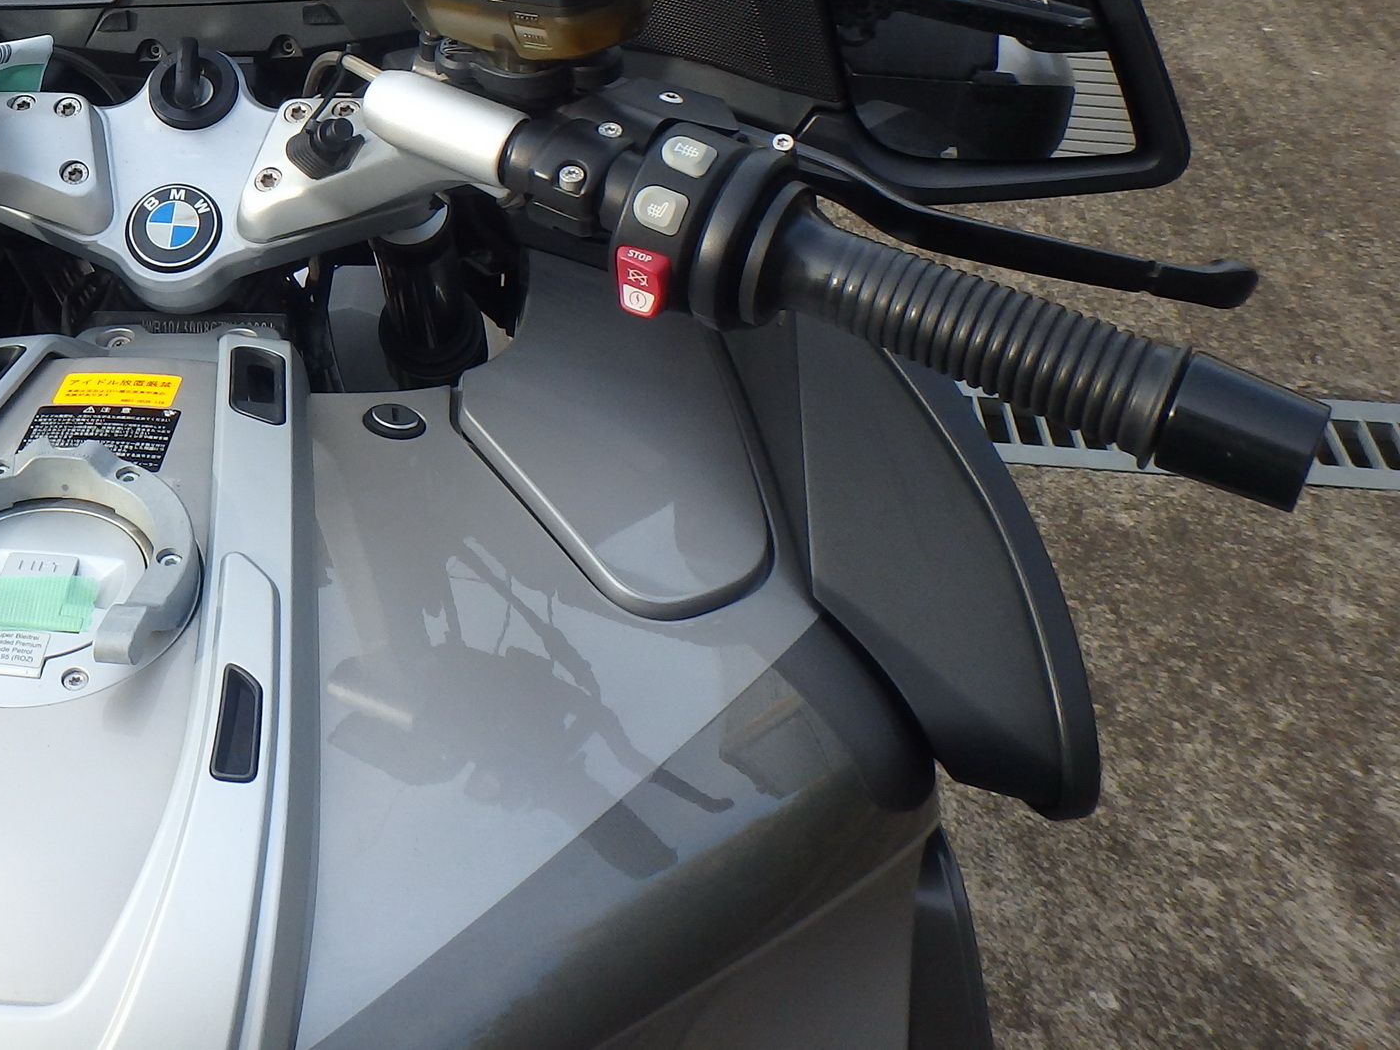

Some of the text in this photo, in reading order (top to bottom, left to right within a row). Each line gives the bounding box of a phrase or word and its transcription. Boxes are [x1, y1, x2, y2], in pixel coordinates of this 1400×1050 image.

[143, 189, 210, 214] BMW
[627, 249, 653, 262] STOP
[18, 560, 63, 572] LIFT
[15, 640, 42, 648] Premium
[11, 647, 33, 655] Petrol
[11, 654, 34, 663] (ROZ)
